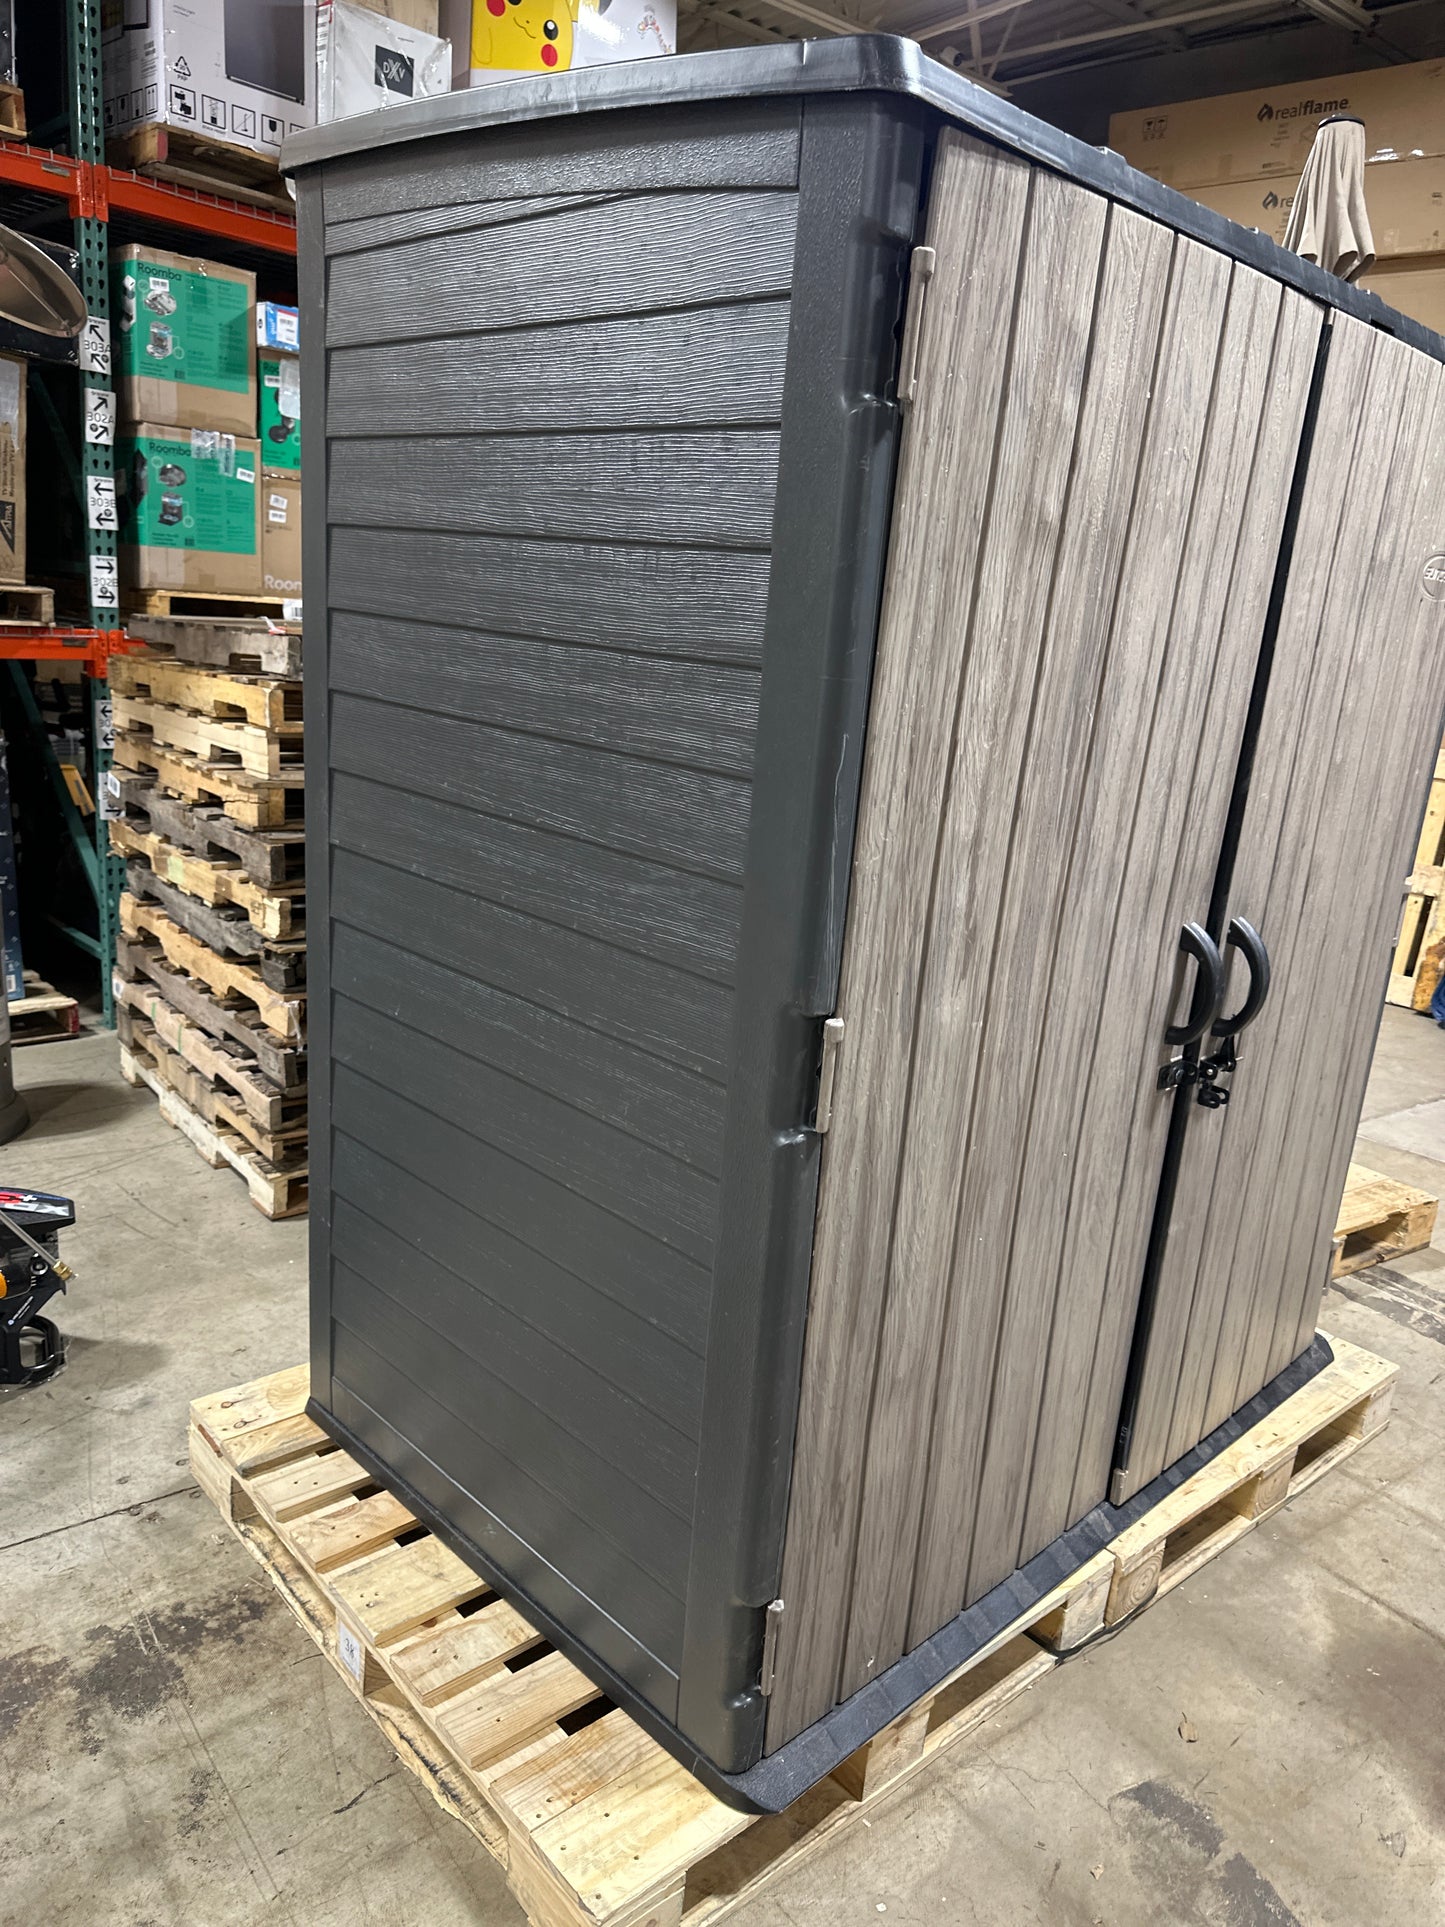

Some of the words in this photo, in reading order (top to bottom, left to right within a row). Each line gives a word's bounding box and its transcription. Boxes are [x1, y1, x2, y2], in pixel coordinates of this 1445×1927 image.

[383, 58, 406, 83] DXV
[1275, 98, 1349, 120] realflame
[137, 262, 182, 281] Roomba
[149, 442, 191, 456] Roomba
